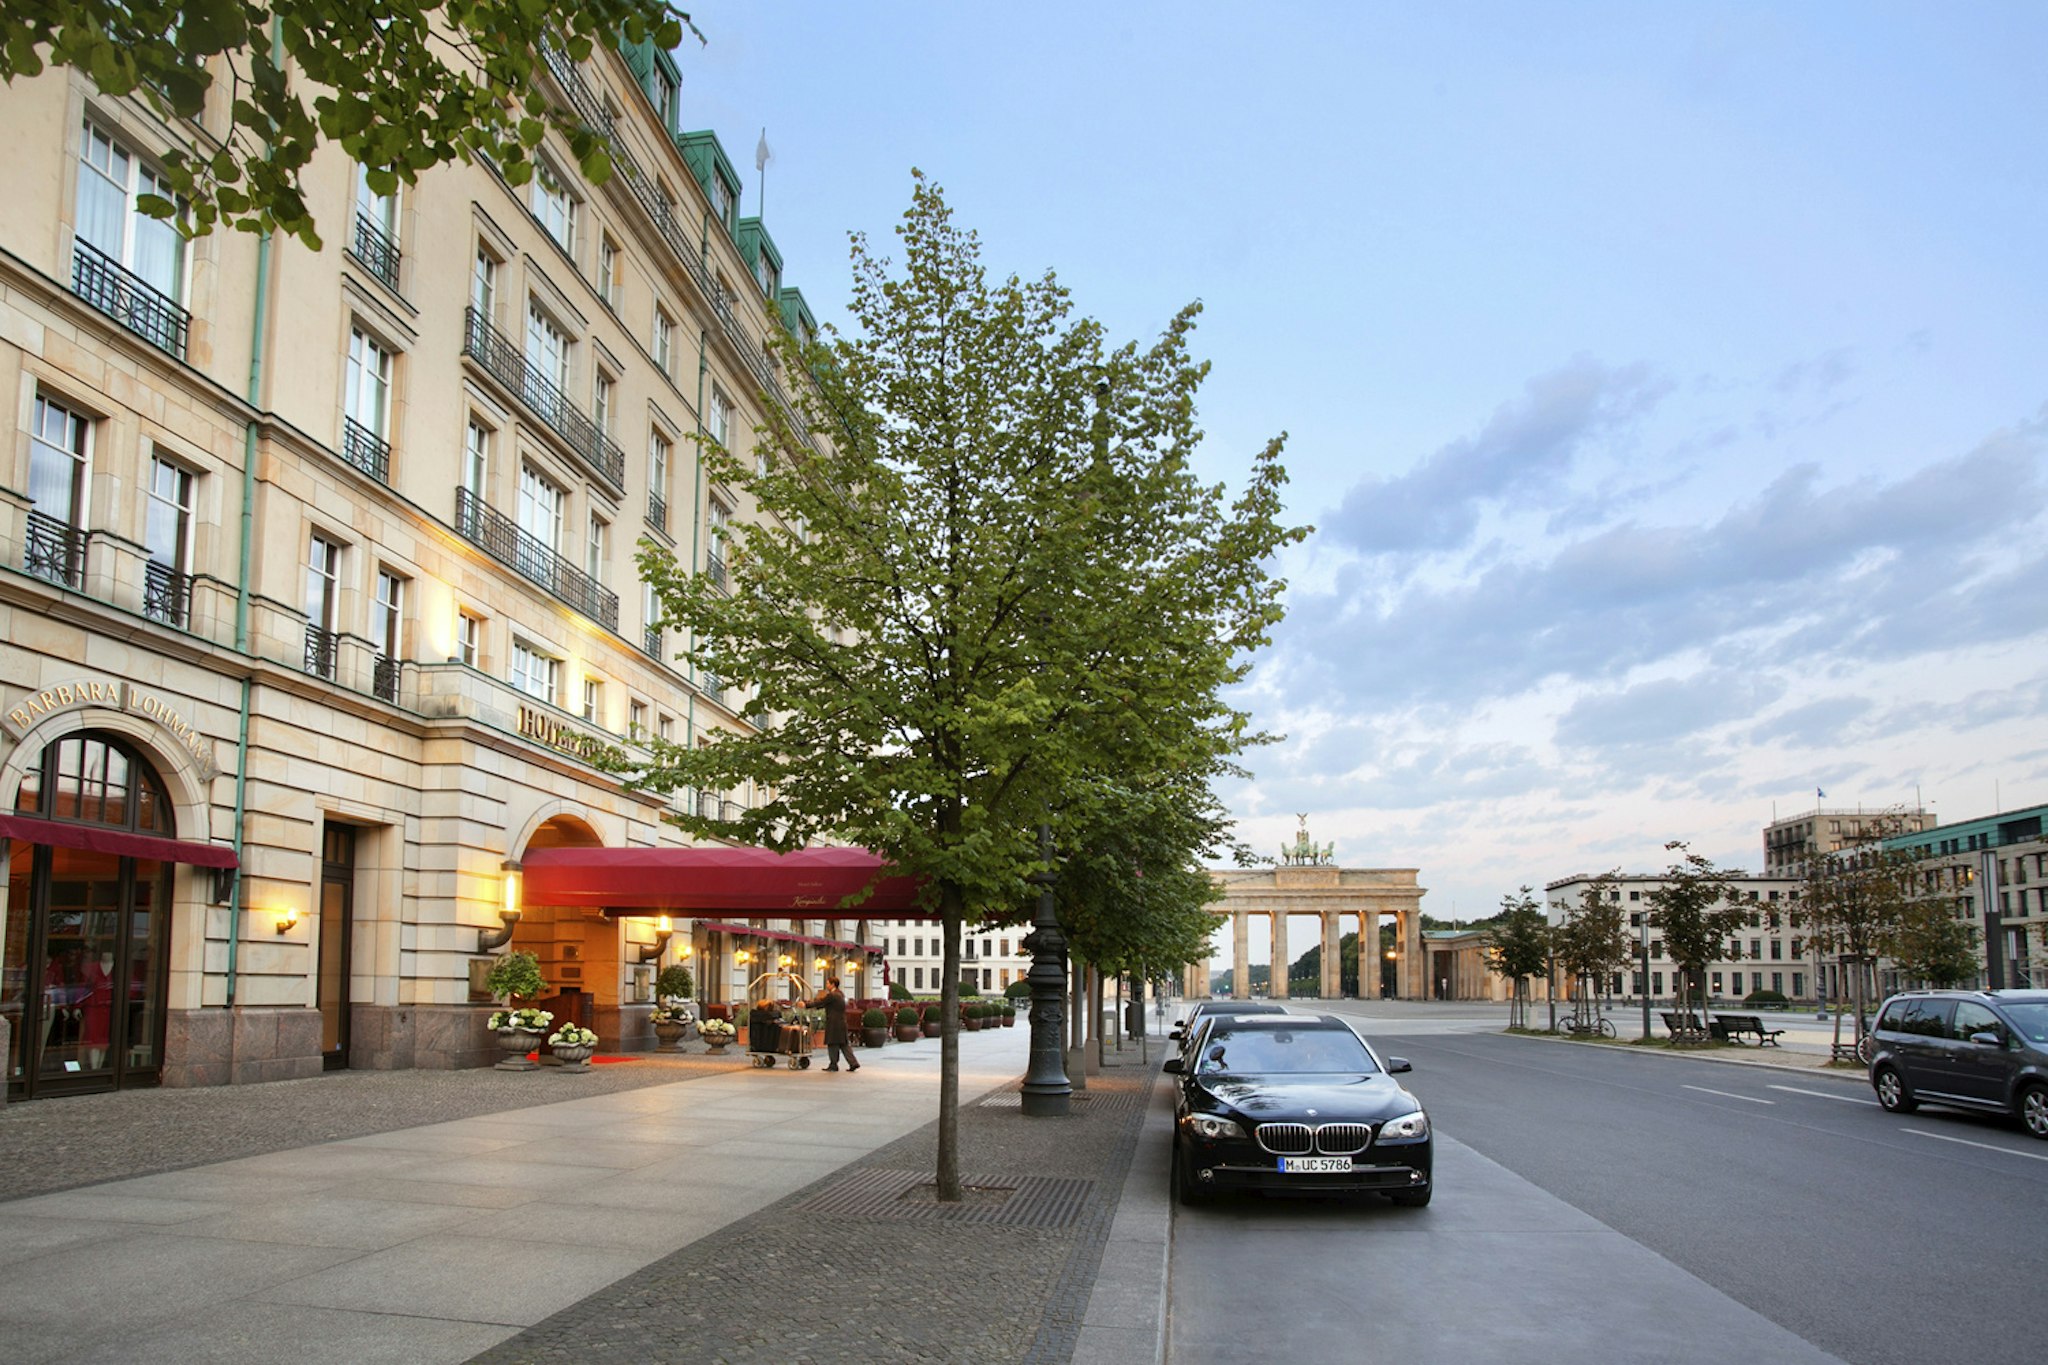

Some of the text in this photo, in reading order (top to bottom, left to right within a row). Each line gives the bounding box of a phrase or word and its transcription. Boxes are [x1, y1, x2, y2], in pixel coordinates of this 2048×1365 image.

[9, 681, 213, 773] BARBARA LOHMANN
[1321, 1159, 1351, 1171] 5786
